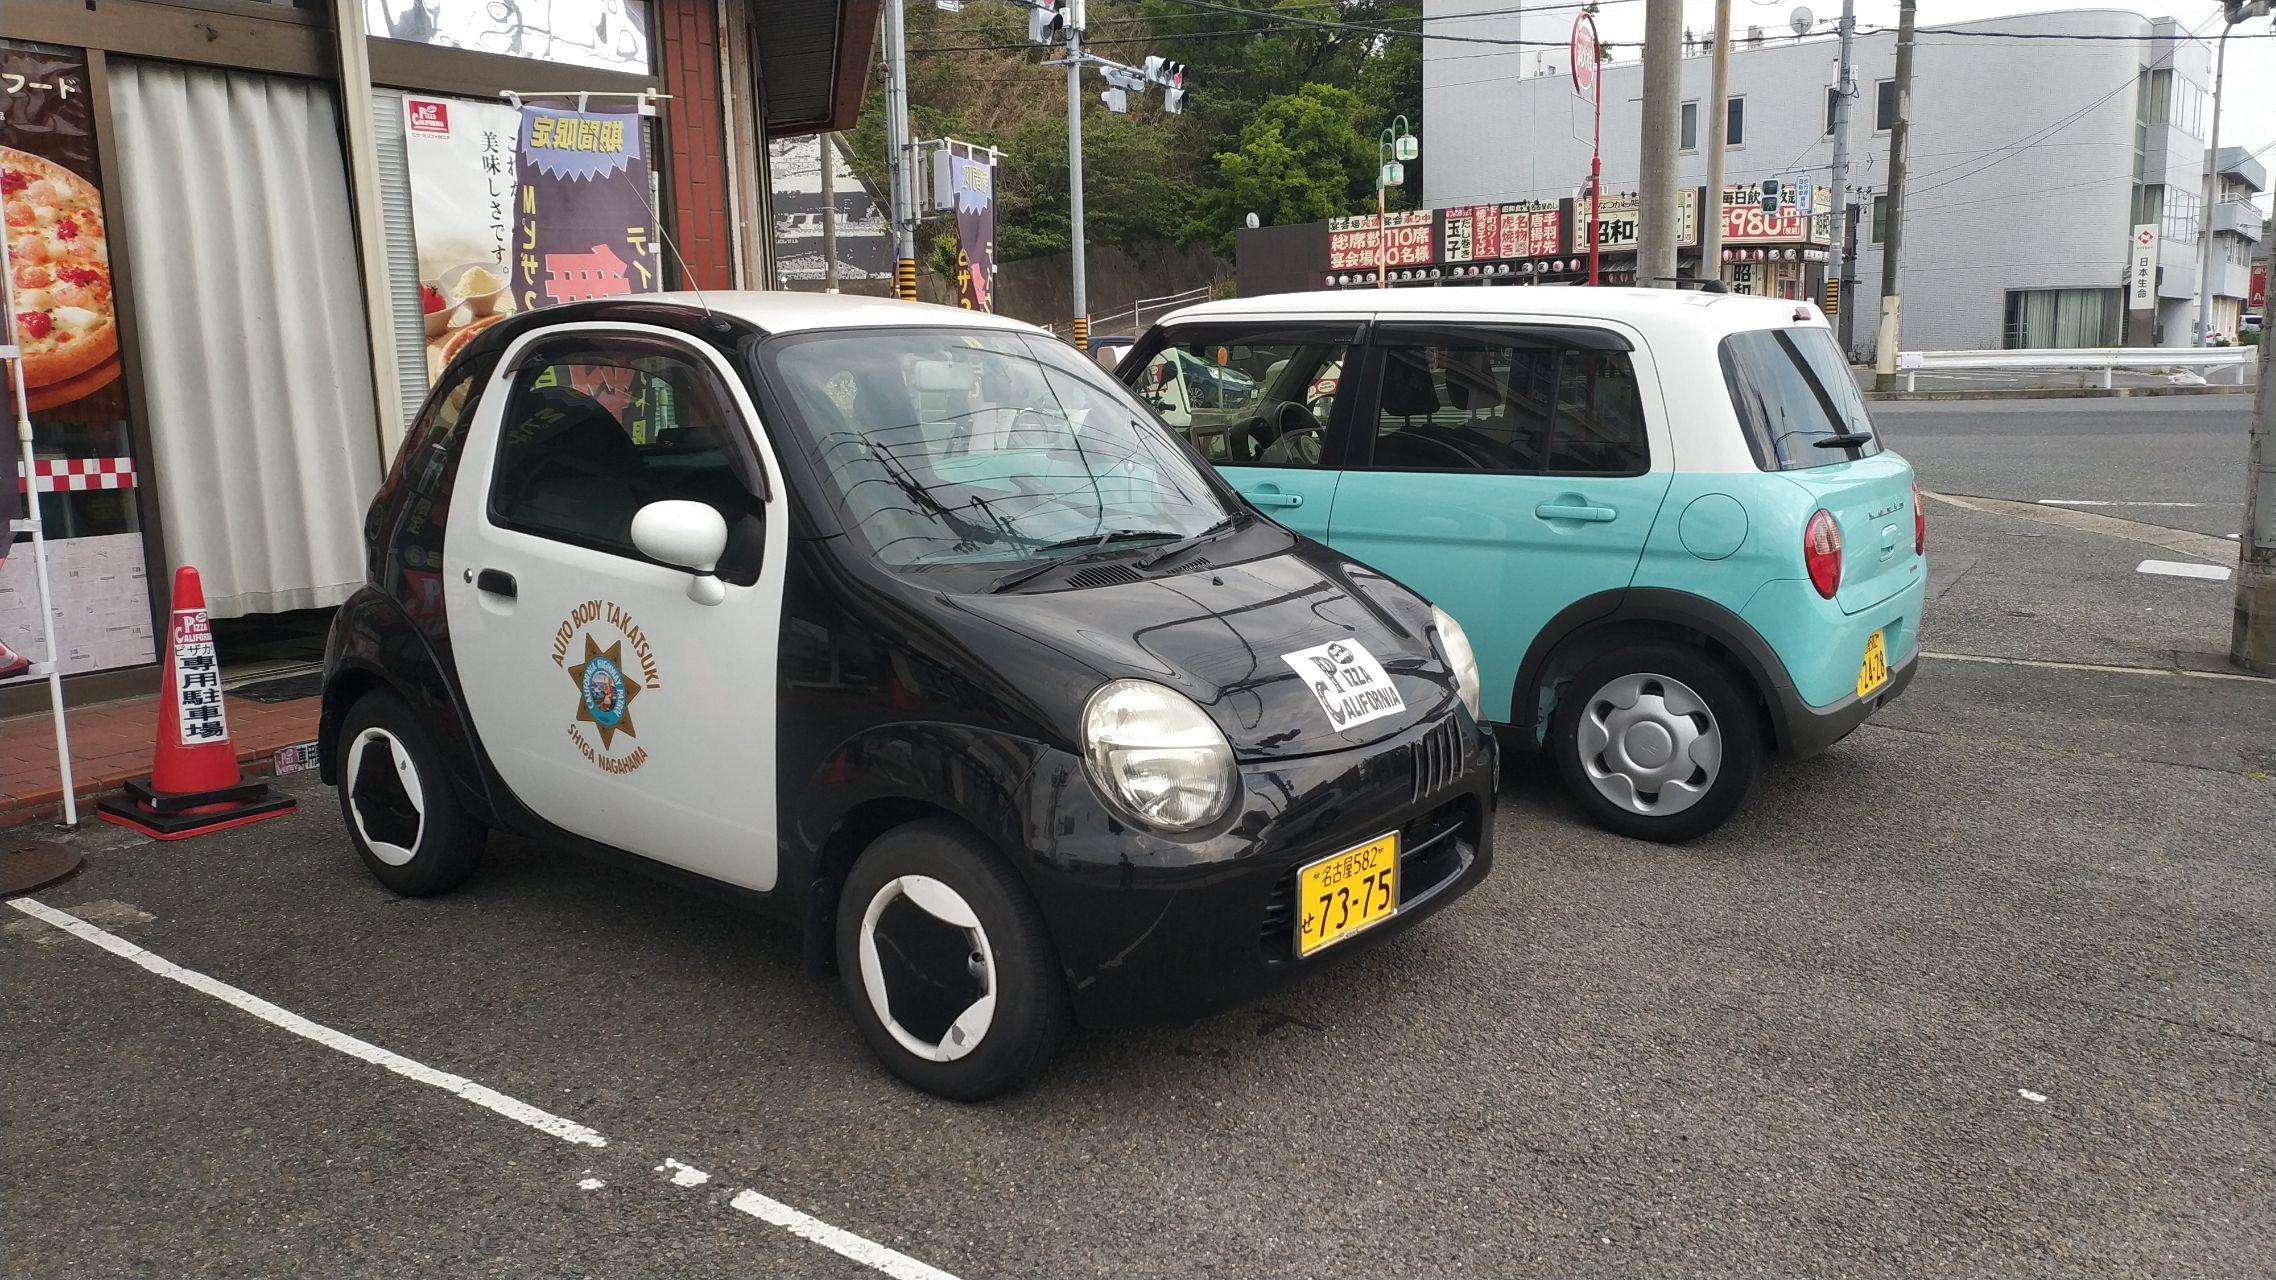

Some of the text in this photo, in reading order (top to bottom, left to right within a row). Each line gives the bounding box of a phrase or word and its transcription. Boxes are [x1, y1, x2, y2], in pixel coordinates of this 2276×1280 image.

[481, 130, 510, 275] 美味しさです。
[1447, 220, 1461, 259] 玉子
[1543, 212, 1557, 255] 手羽先
[2137, 257, 2148, 298] 日本生命
[552, 600, 661, 689] AUTO BODY TAKATSUKI
[179, 655, 224, 738] 専用駐車場
[1308, 656, 1374, 693] PIZZA
[1315, 680, 1402, 725] CALIFORNIA
[567, 723, 648, 775] SHIGA NAGAHAMA
[1320, 867, 1391, 937] 73-75
